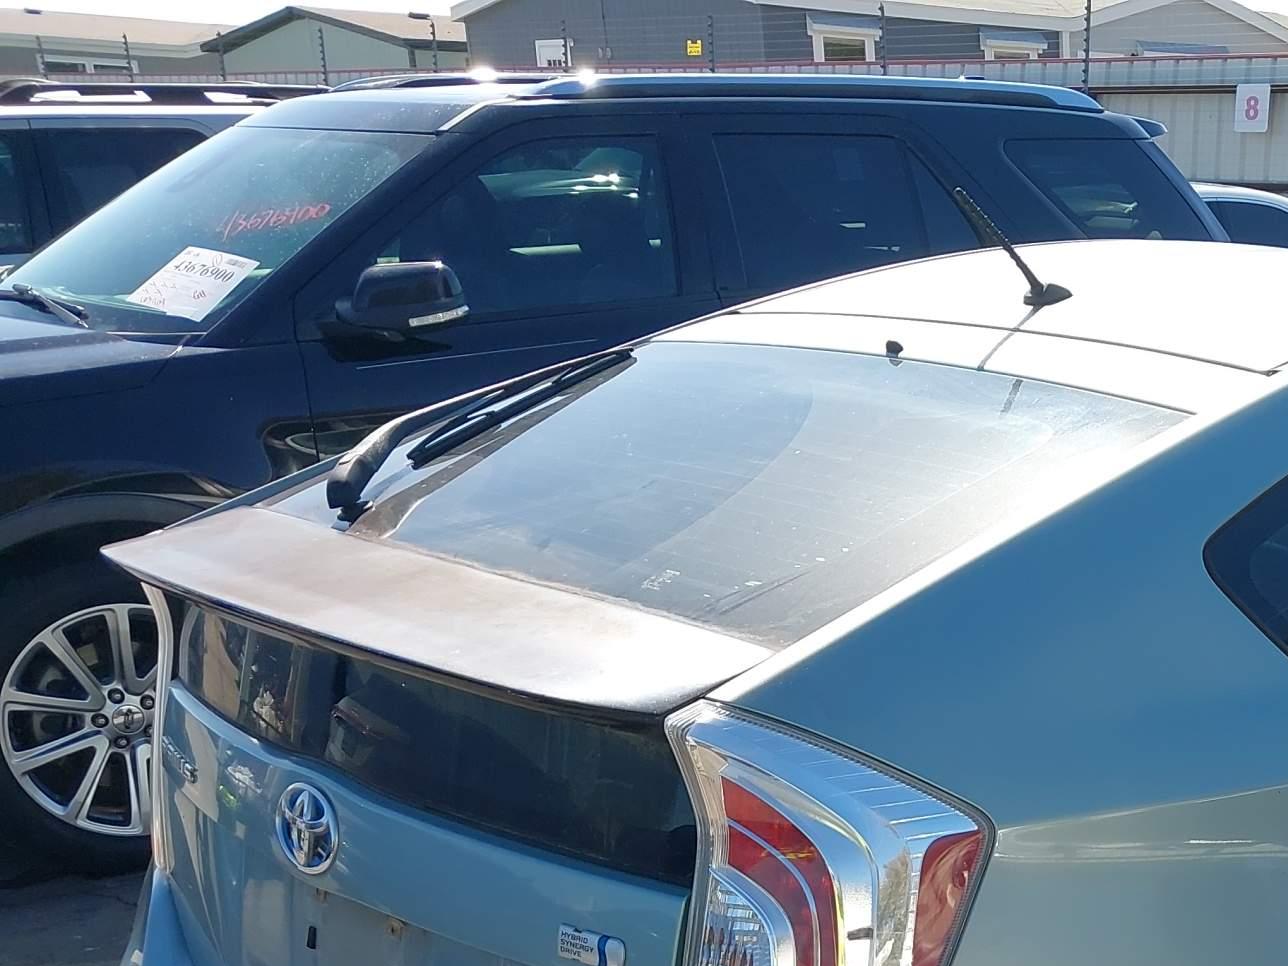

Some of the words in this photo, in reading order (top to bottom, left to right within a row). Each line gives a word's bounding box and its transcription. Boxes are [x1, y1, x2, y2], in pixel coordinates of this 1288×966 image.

[1245, 95, 1259, 121] 8
[560, 931, 589, 944] HYBRID
[560, 939, 594, 953] SYNERGY
[560, 946, 582, 958] DRIVE
